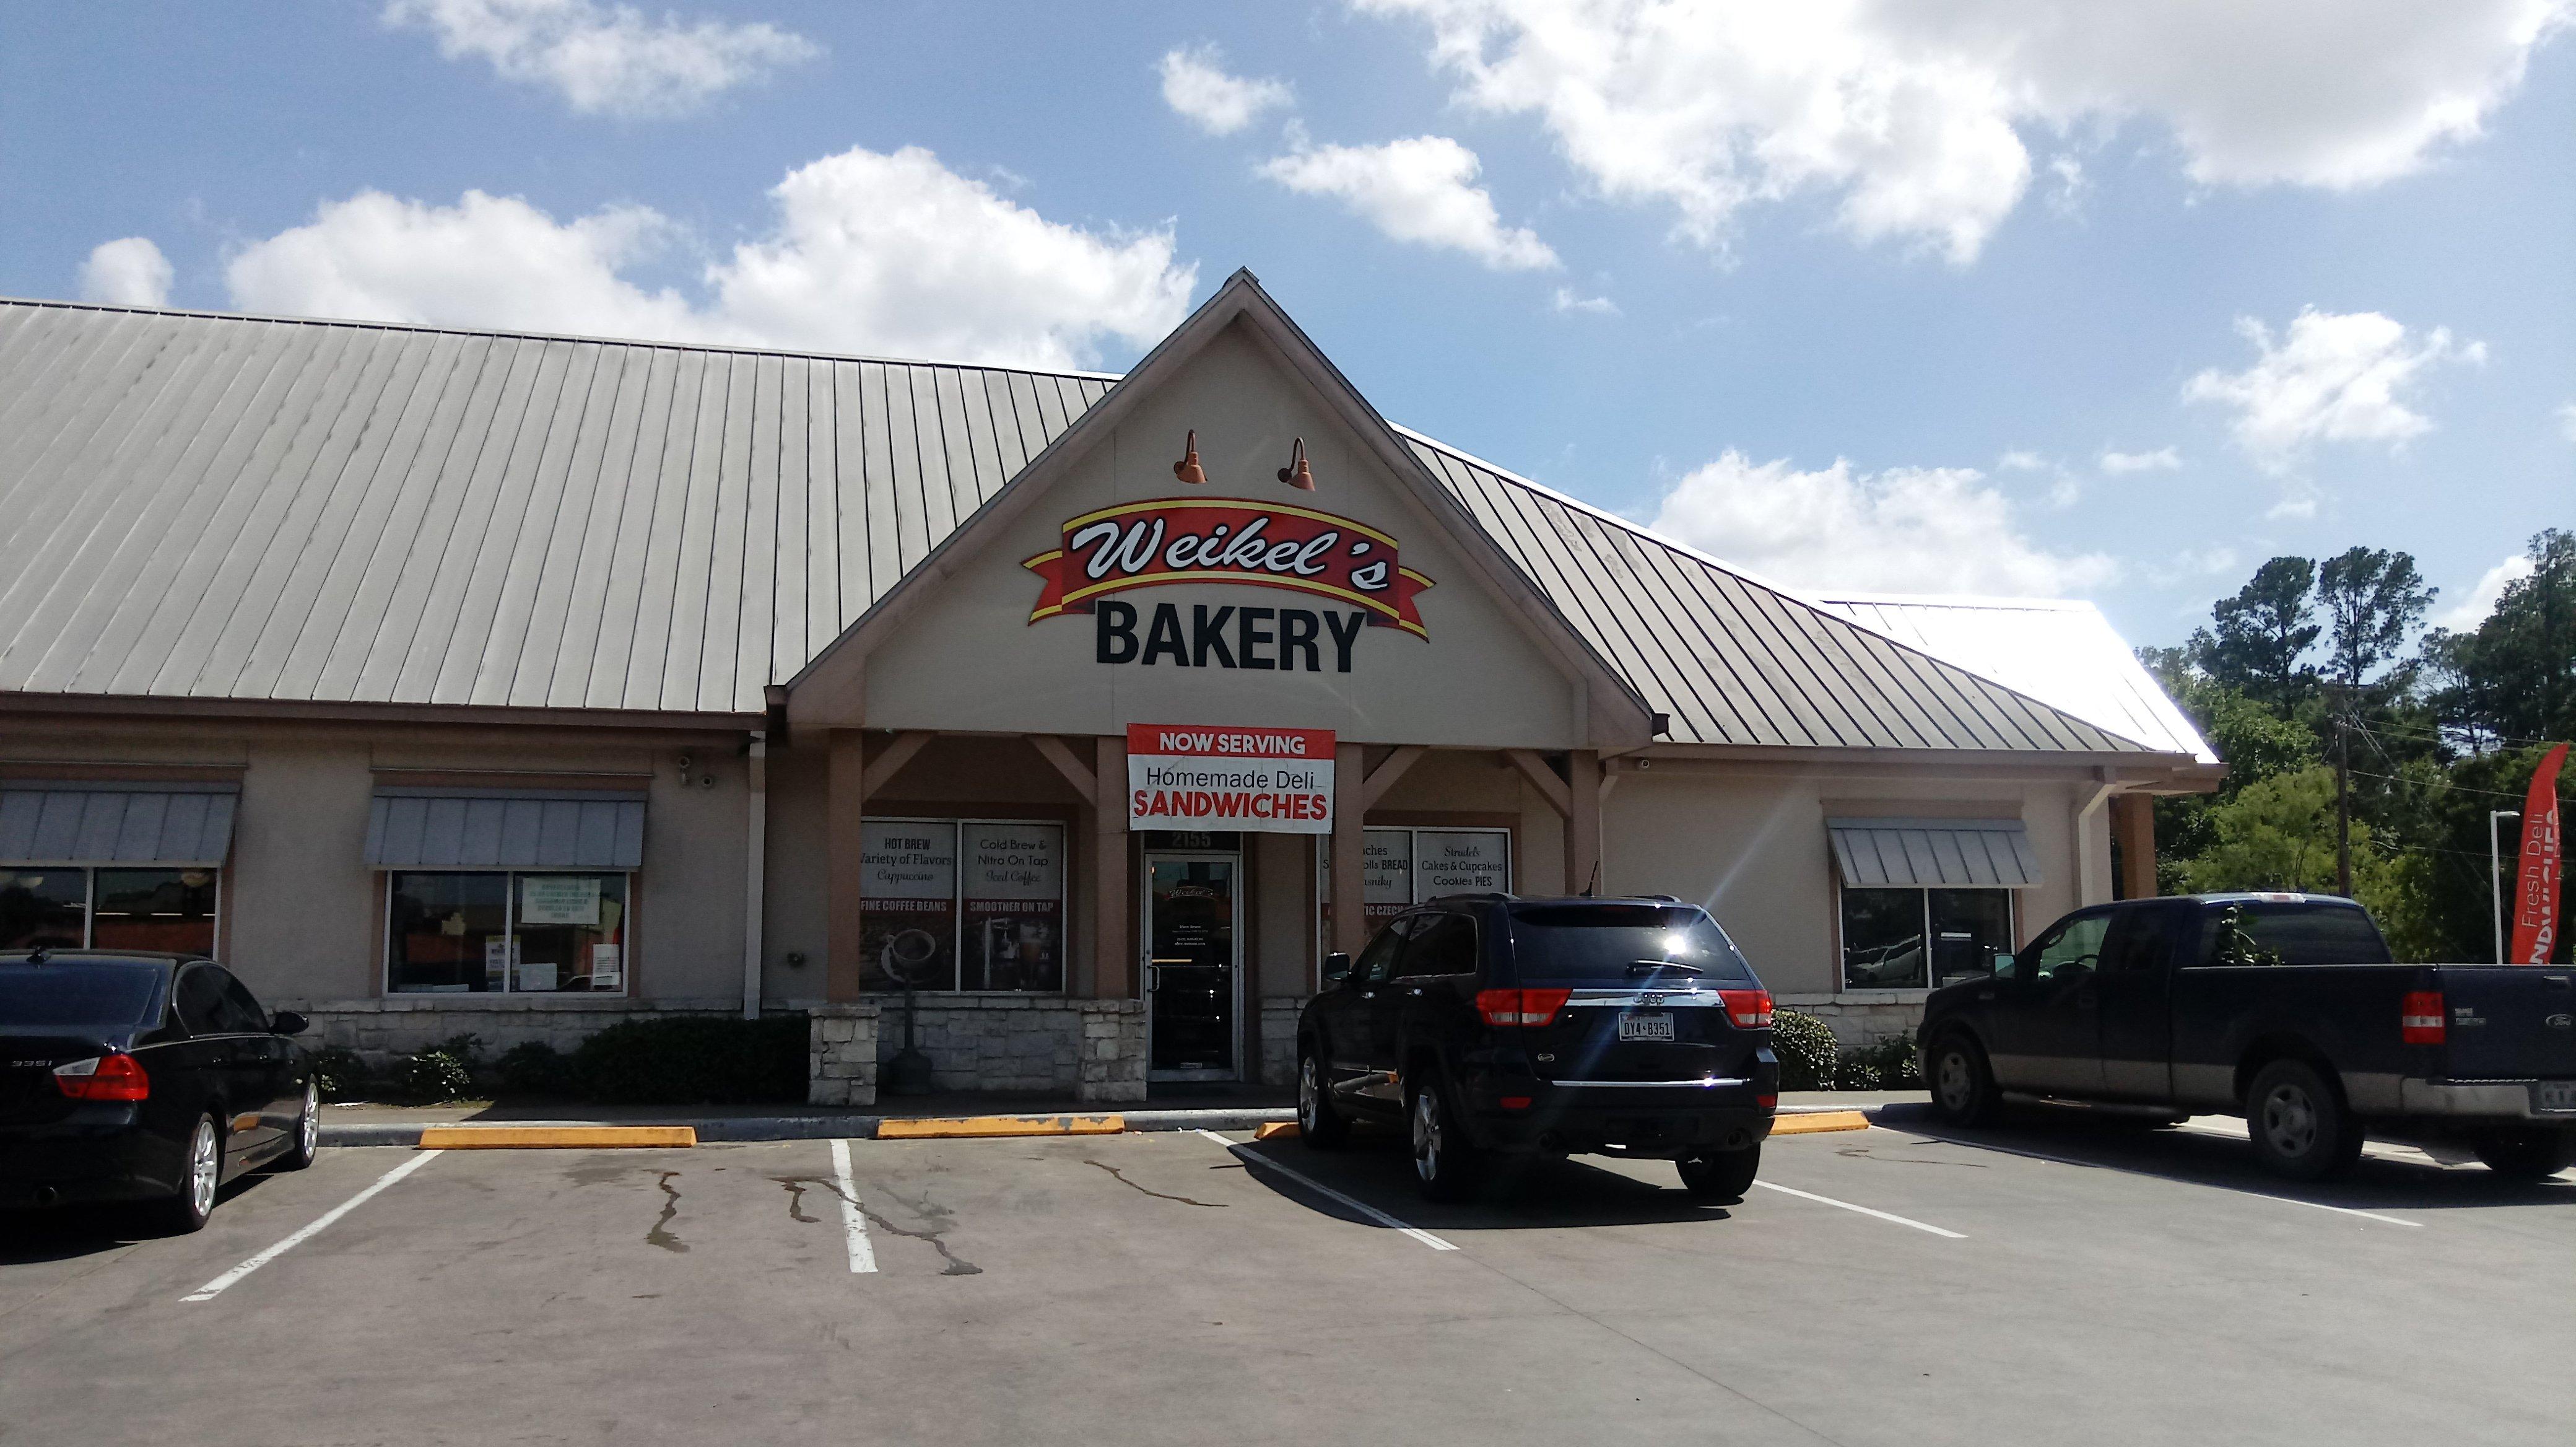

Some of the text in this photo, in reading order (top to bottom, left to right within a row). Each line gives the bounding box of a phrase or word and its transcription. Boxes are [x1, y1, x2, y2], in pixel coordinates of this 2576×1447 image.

[1072, 517, 1389, 590] Weikel's
[1096, 600, 1365, 673] BAKERY
[1159, 732, 1306, 754] NOW SERVING
[1147, 767, 1314, 790] Homemade Deli
[1134, 790, 1327, 821] SANDWICHES
[884, 838, 930, 850] HOT BREW
[980, 839, 1007, 849] Cold
[1010, 839, 1036, 850] Brew
[1172, 831, 1211, 847] 2155
[1363, 845, 1388, 855] ches
[900, 853, 912, 864] of
[913, 854, 952, 865] Flavors
[978, 855, 1048, 867] Nitro On Tap
[1364, 859, 1408, 870] olls BREAD
[1422, 860, 1502, 873] Cakes & Cupcakes
[2522, 813, 2544, 927] Fresh Deli
[1433, 875, 1492, 886] Cookies PIES
[861, 900, 947, 912] FINE COFFEE BEANS
[970, 901, 1054, 912] SMOOTHER ON TAP
